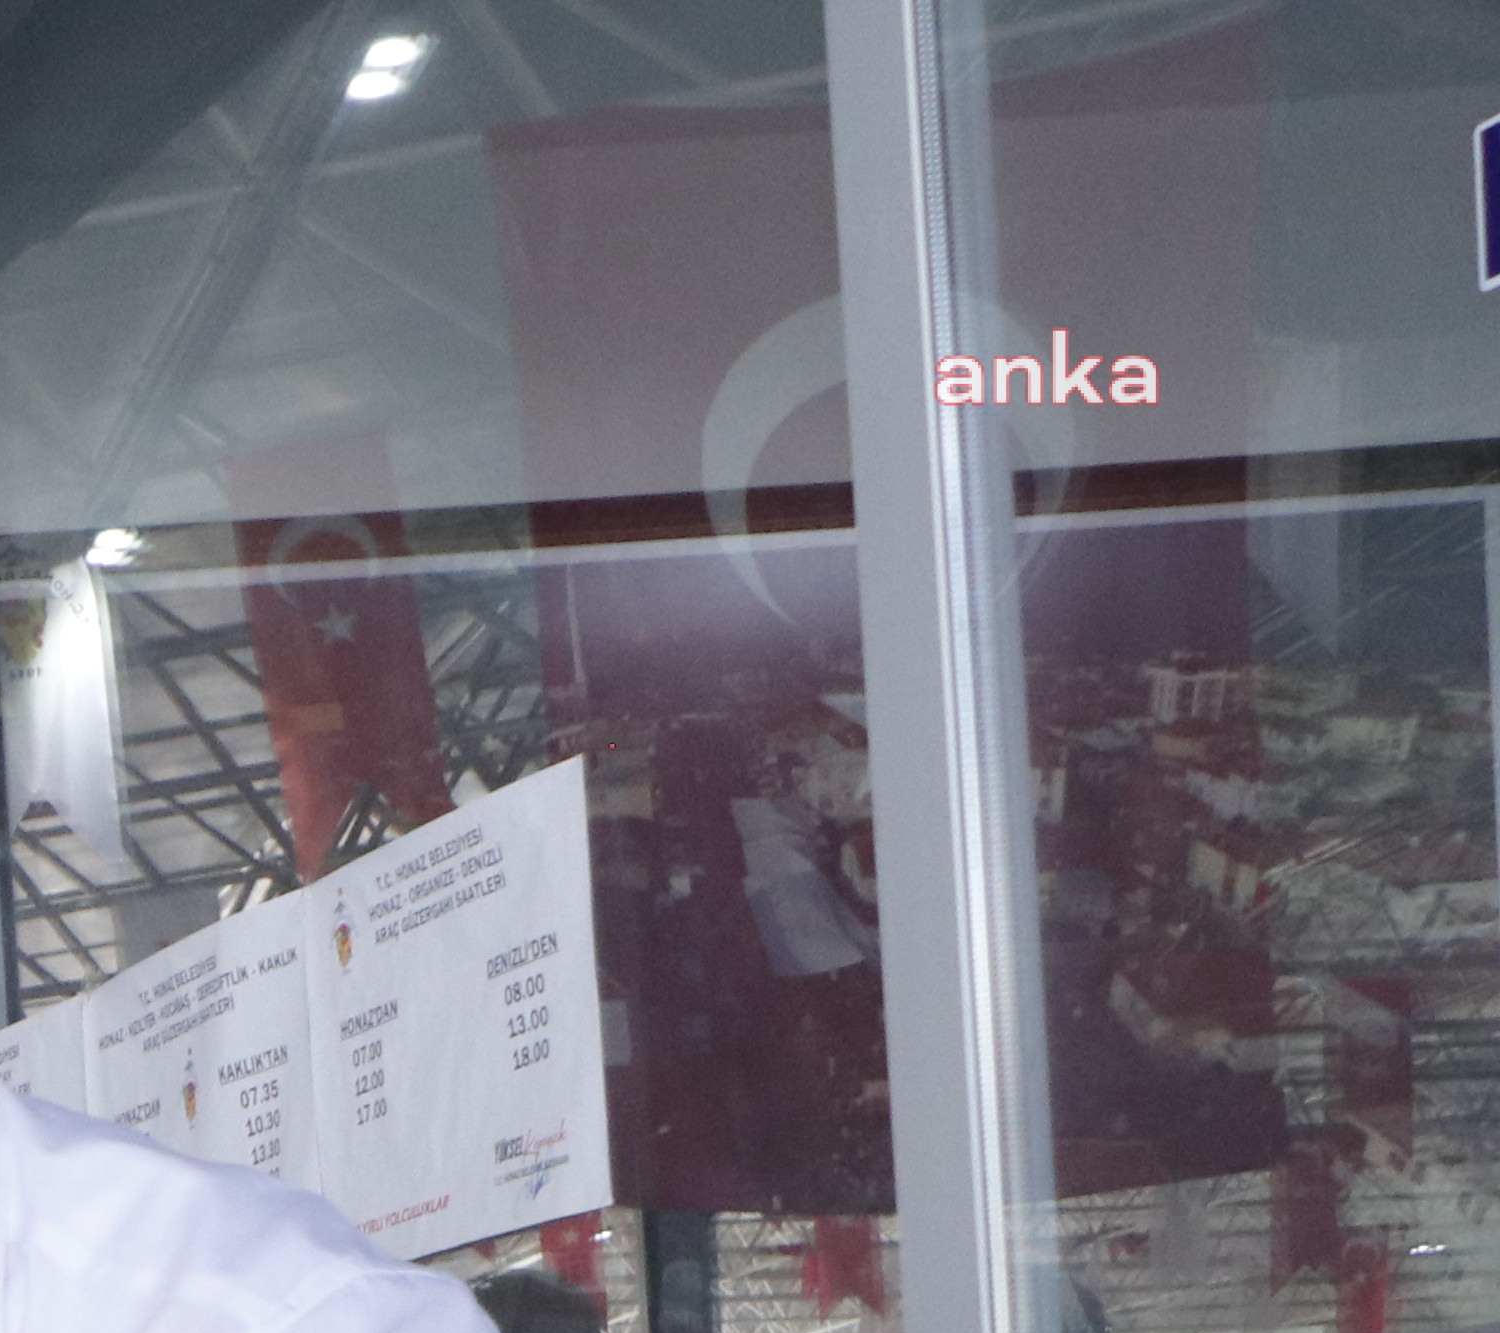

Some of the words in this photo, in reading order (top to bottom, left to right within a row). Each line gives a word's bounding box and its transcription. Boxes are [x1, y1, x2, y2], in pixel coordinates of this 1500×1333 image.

[396, 861, 428, 882] HONAZ
[429, 824, 484, 872] BELEDİYESİ
[368, 894, 403, 922] HONAZ
[408, 868, 456, 906] ORGANİZE
[462, 844, 504, 879] DENİZLİ
[374, 923, 400, 944] ARAÇ
[455, 872, 507, 908] SAATLERİ
[258, 948, 299, 978] KAKLIK
[487, 931, 559, 979] DENİZLİ'DEN
[504, 973, 545, 1006] 08.00
[340, 1000, 398, 1040] HONAZ'DAN
[508, 1005, 549, 1038] 13.00
[217, 1045, 290, 1086] KAKLIK'TAN
[352, 1040, 382, 1068] 07.00
[513, 1038, 550, 1071] 18.00
[240, 1079, 280, 1110] 07.35
[355, 1069, 385, 1096] 12.00
[245, 1109, 281, 1138] 10.30
[357, 1098, 387, 1126] 17.00
[251, 1138, 281, 1166] 13.30
